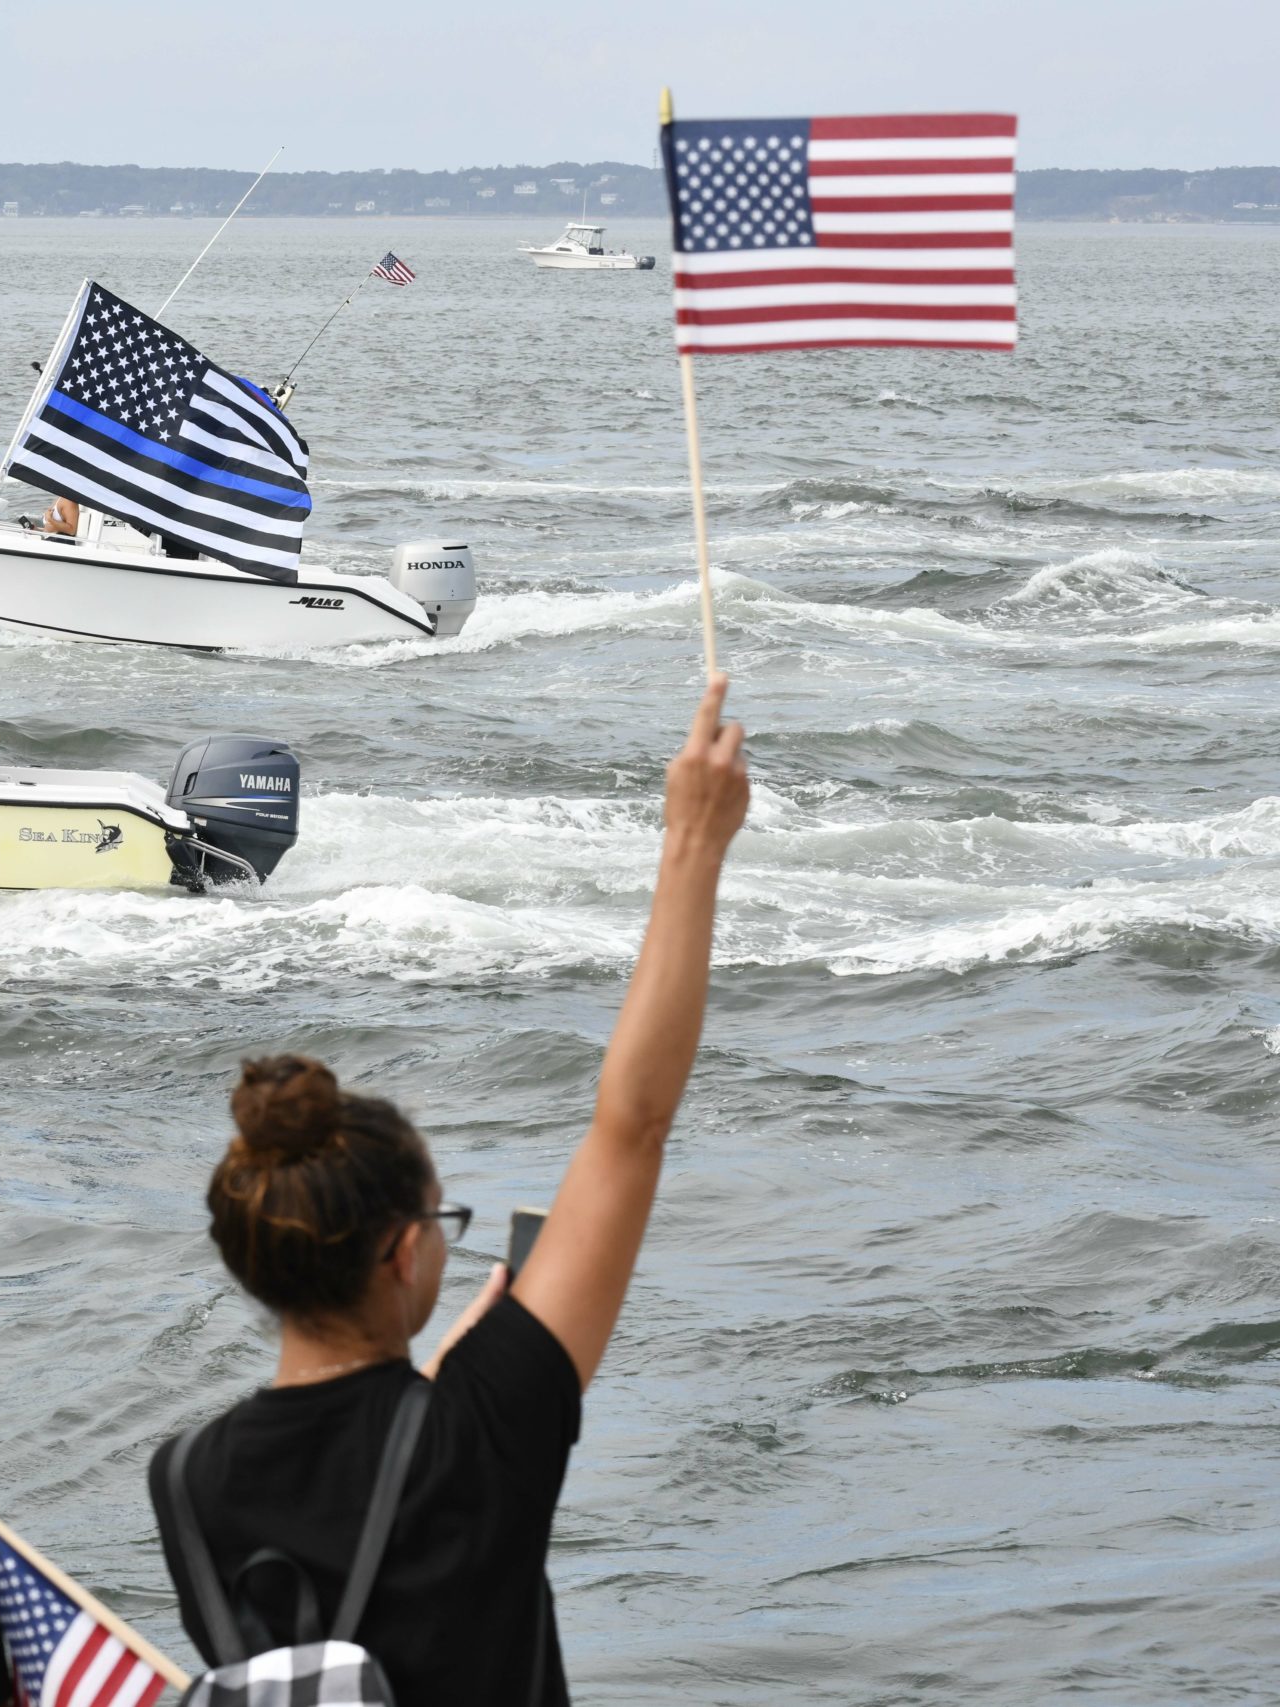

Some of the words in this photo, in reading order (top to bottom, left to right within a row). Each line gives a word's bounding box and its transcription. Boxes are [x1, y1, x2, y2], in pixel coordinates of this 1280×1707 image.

[407, 560, 466, 571] HONDA
[288, 596, 345, 610] MAKO
[239, 773, 291, 792] YAMAHA
